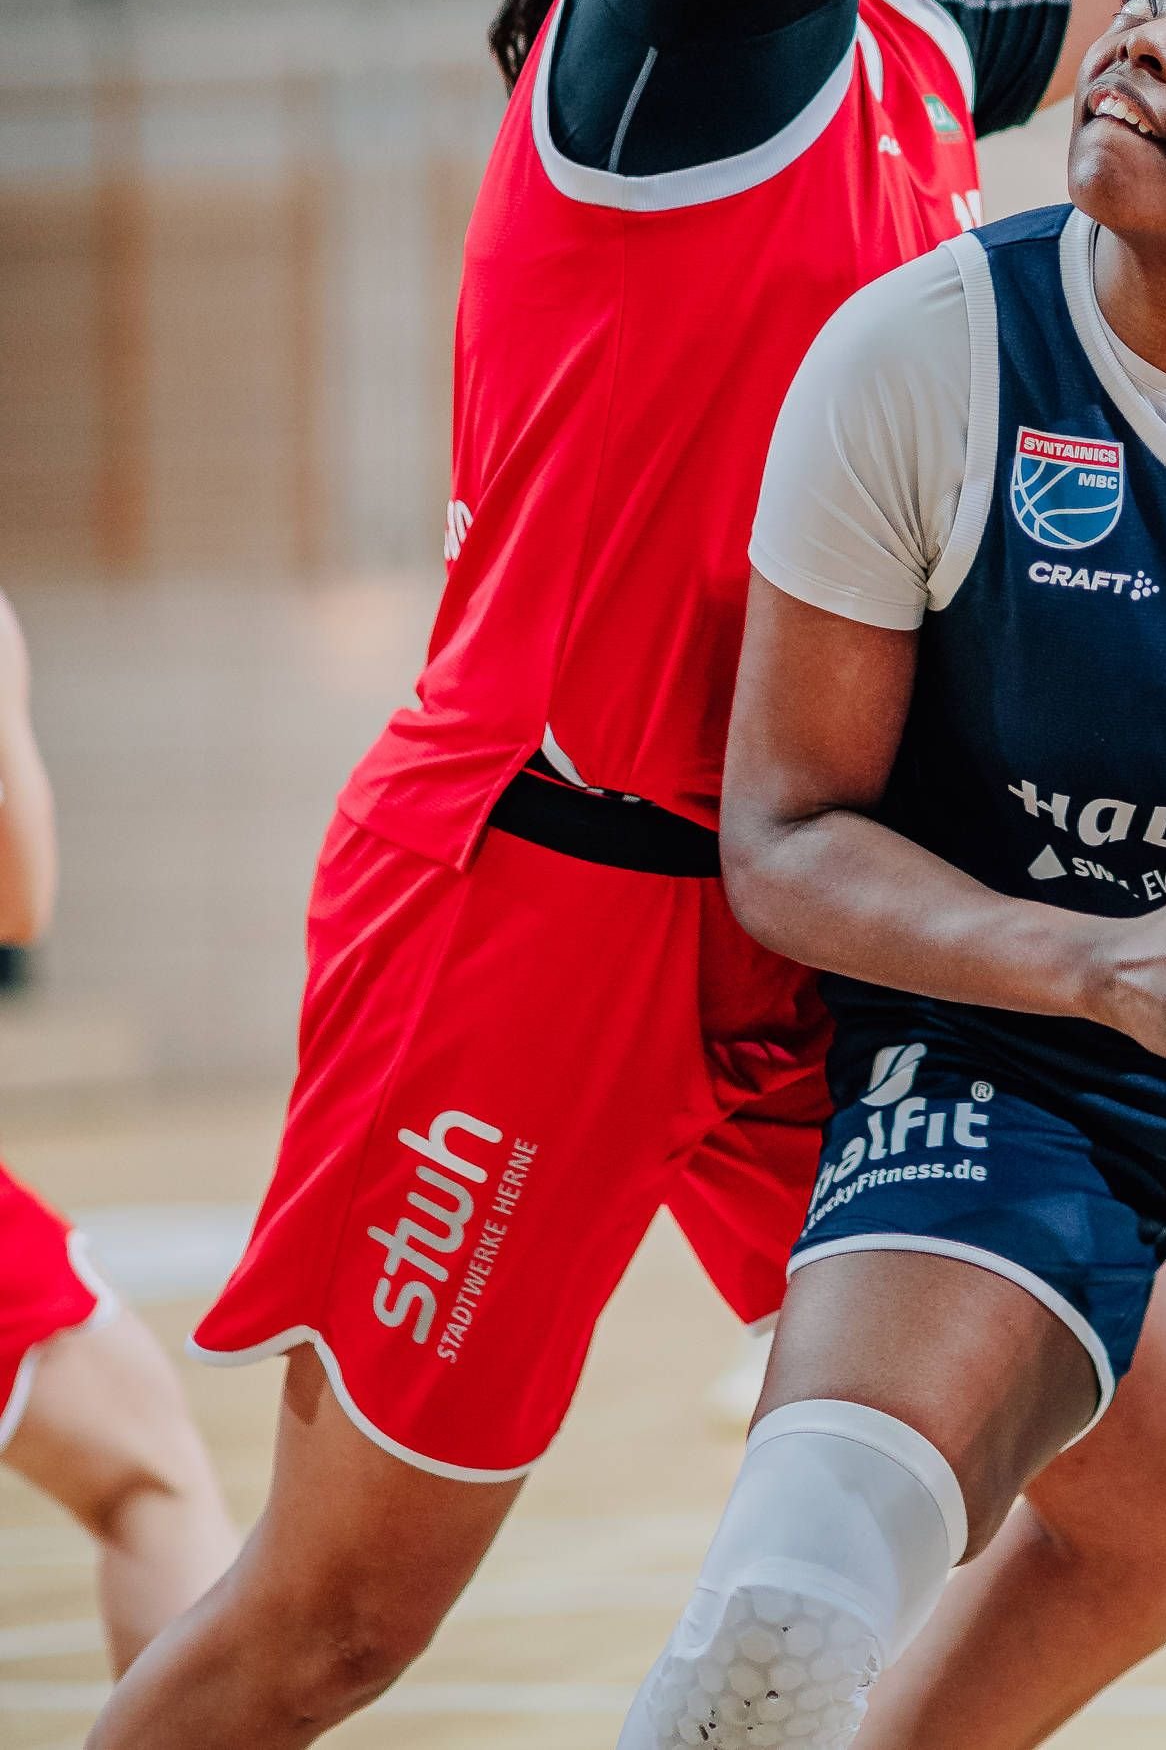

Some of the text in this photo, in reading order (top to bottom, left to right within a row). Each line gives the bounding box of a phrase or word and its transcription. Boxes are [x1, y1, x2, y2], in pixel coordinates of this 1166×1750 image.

[1023, 436, 1119, 464] SYNTAINICS
[1078, 472, 1118, 490] MBC
[1028, 560, 1132, 594] CRAFT
[366, 1109, 504, 1345] stwh
[436, 1137, 539, 1364] STADTWERKE HERNE
